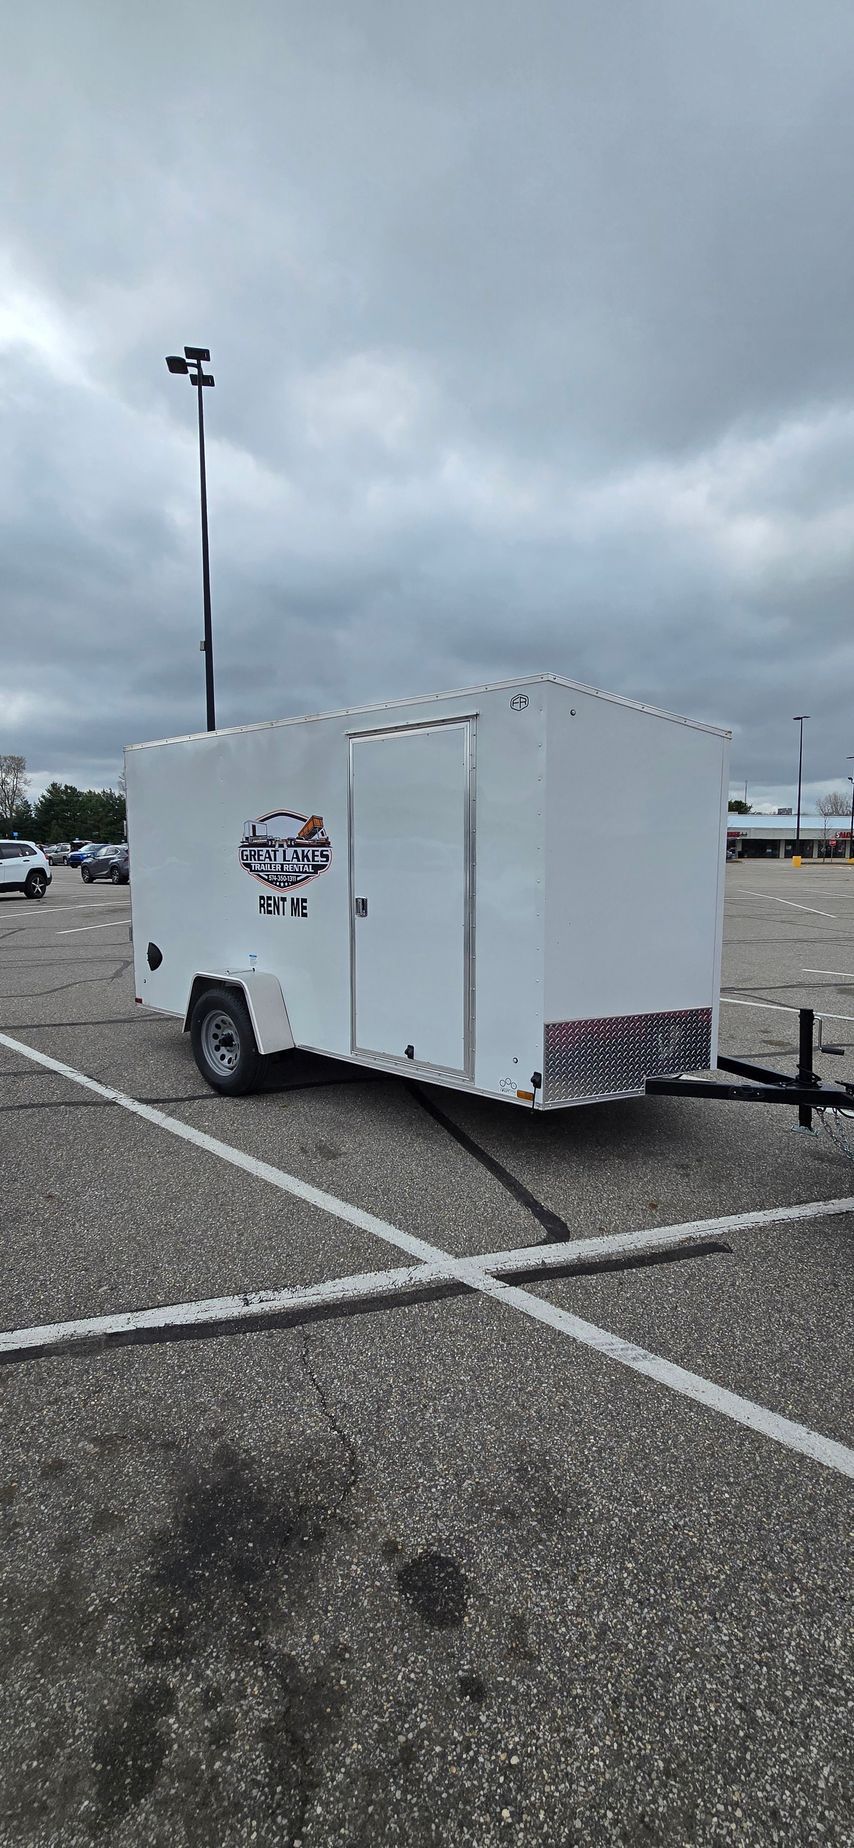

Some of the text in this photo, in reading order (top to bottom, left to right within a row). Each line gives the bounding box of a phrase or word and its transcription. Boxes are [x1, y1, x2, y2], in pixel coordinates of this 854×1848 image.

[240, 849, 330, 863] GREAT LAKES
[251, 863, 315, 872] TRAILER RENTAL
[258, 895, 308, 918] RENT ME
